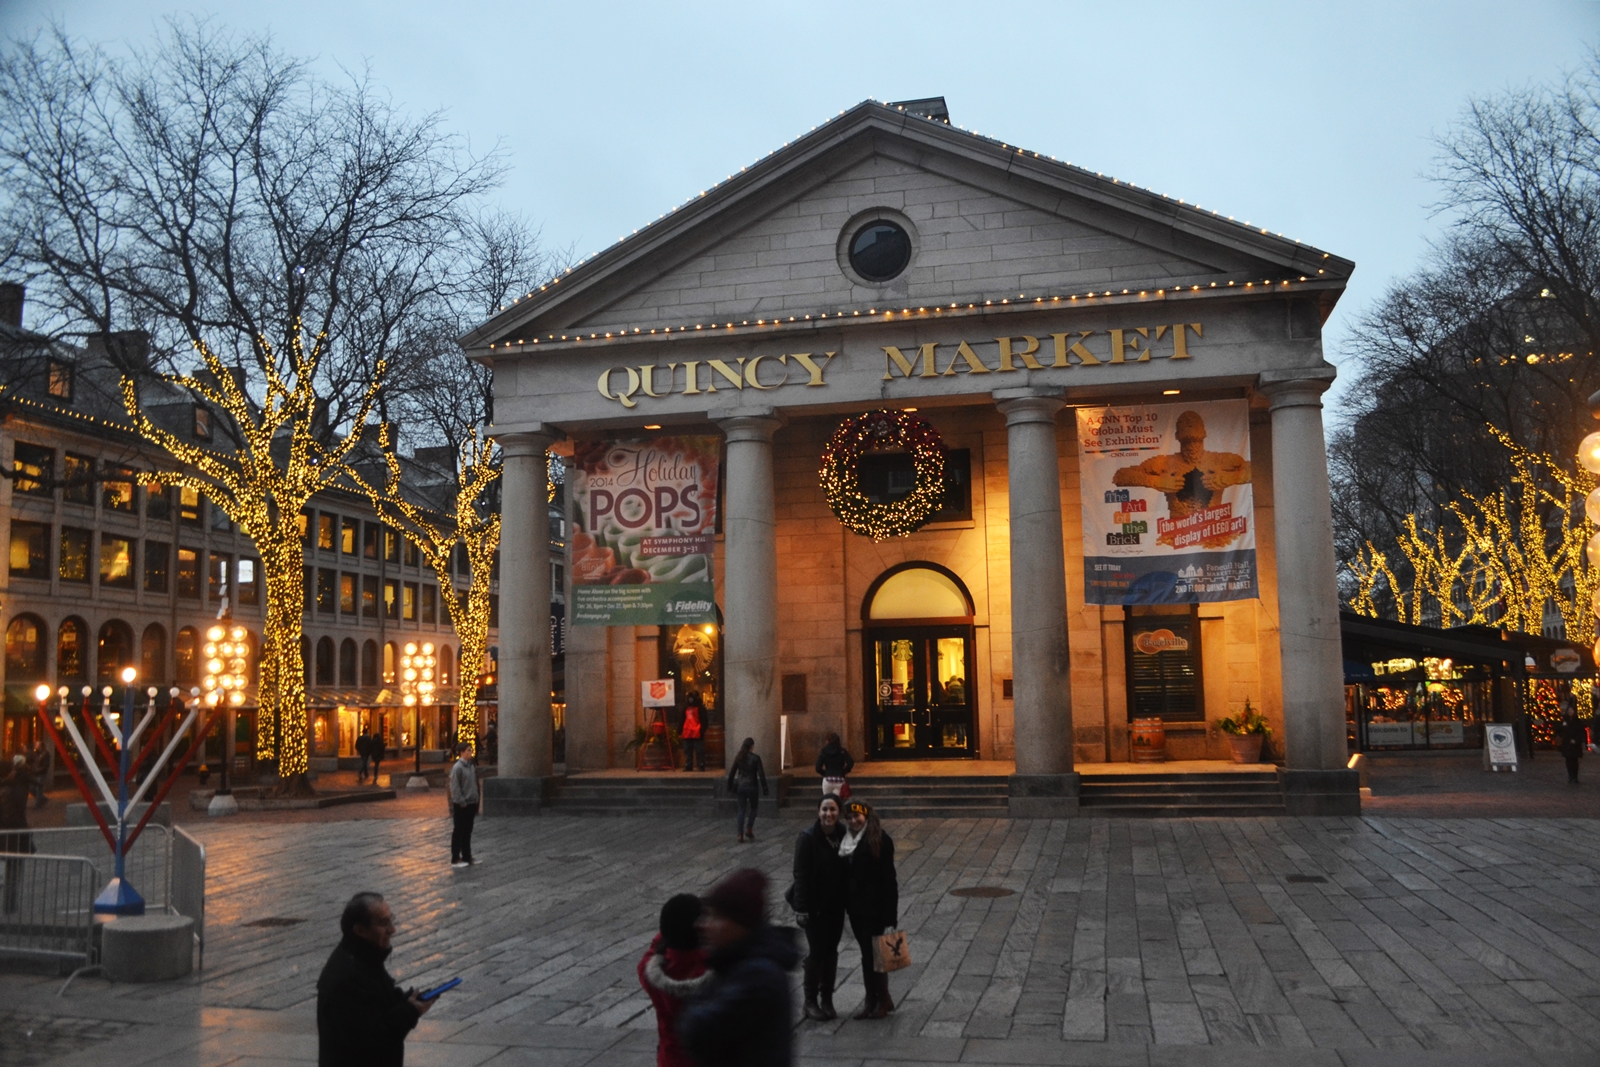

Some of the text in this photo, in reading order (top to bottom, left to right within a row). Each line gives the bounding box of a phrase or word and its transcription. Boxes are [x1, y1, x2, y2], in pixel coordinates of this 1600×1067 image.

[597, 323, 1202, 408] QUINCY MARKET
[1086, 413, 1158, 425] A CNN Top 10
[1127, 425, 1154, 434] Must
[1084, 439, 1103, 447] See
[608, 448, 696, 497] Holiday
[590, 477, 614, 487] 2014
[1106, 493, 1128, 502] The
[590, 484, 700, 531] POPS
[1126, 503, 1143, 512] Art
[1117, 514, 1127, 522] of
[1161, 506, 1231, 533] the world's largest
[1126, 525, 1144, 533] the
[1174, 530, 1201, 546] display
[1202, 527, 1211, 537] of
[1212, 522, 1229, 535] LEGO
[654, 537, 693, 545] SYMPHONY
[1110, 535, 1137, 545] Brick
[643, 546, 681, 554] DECEMBER
[1235, 561, 1250, 569] Hall
[1189, 584, 1205, 592] FLOOR
[1228, 581, 1250, 590] MARKET
[675, 600, 712, 611] Fidelity
[1144, 637, 1186, 647] Bagelville
